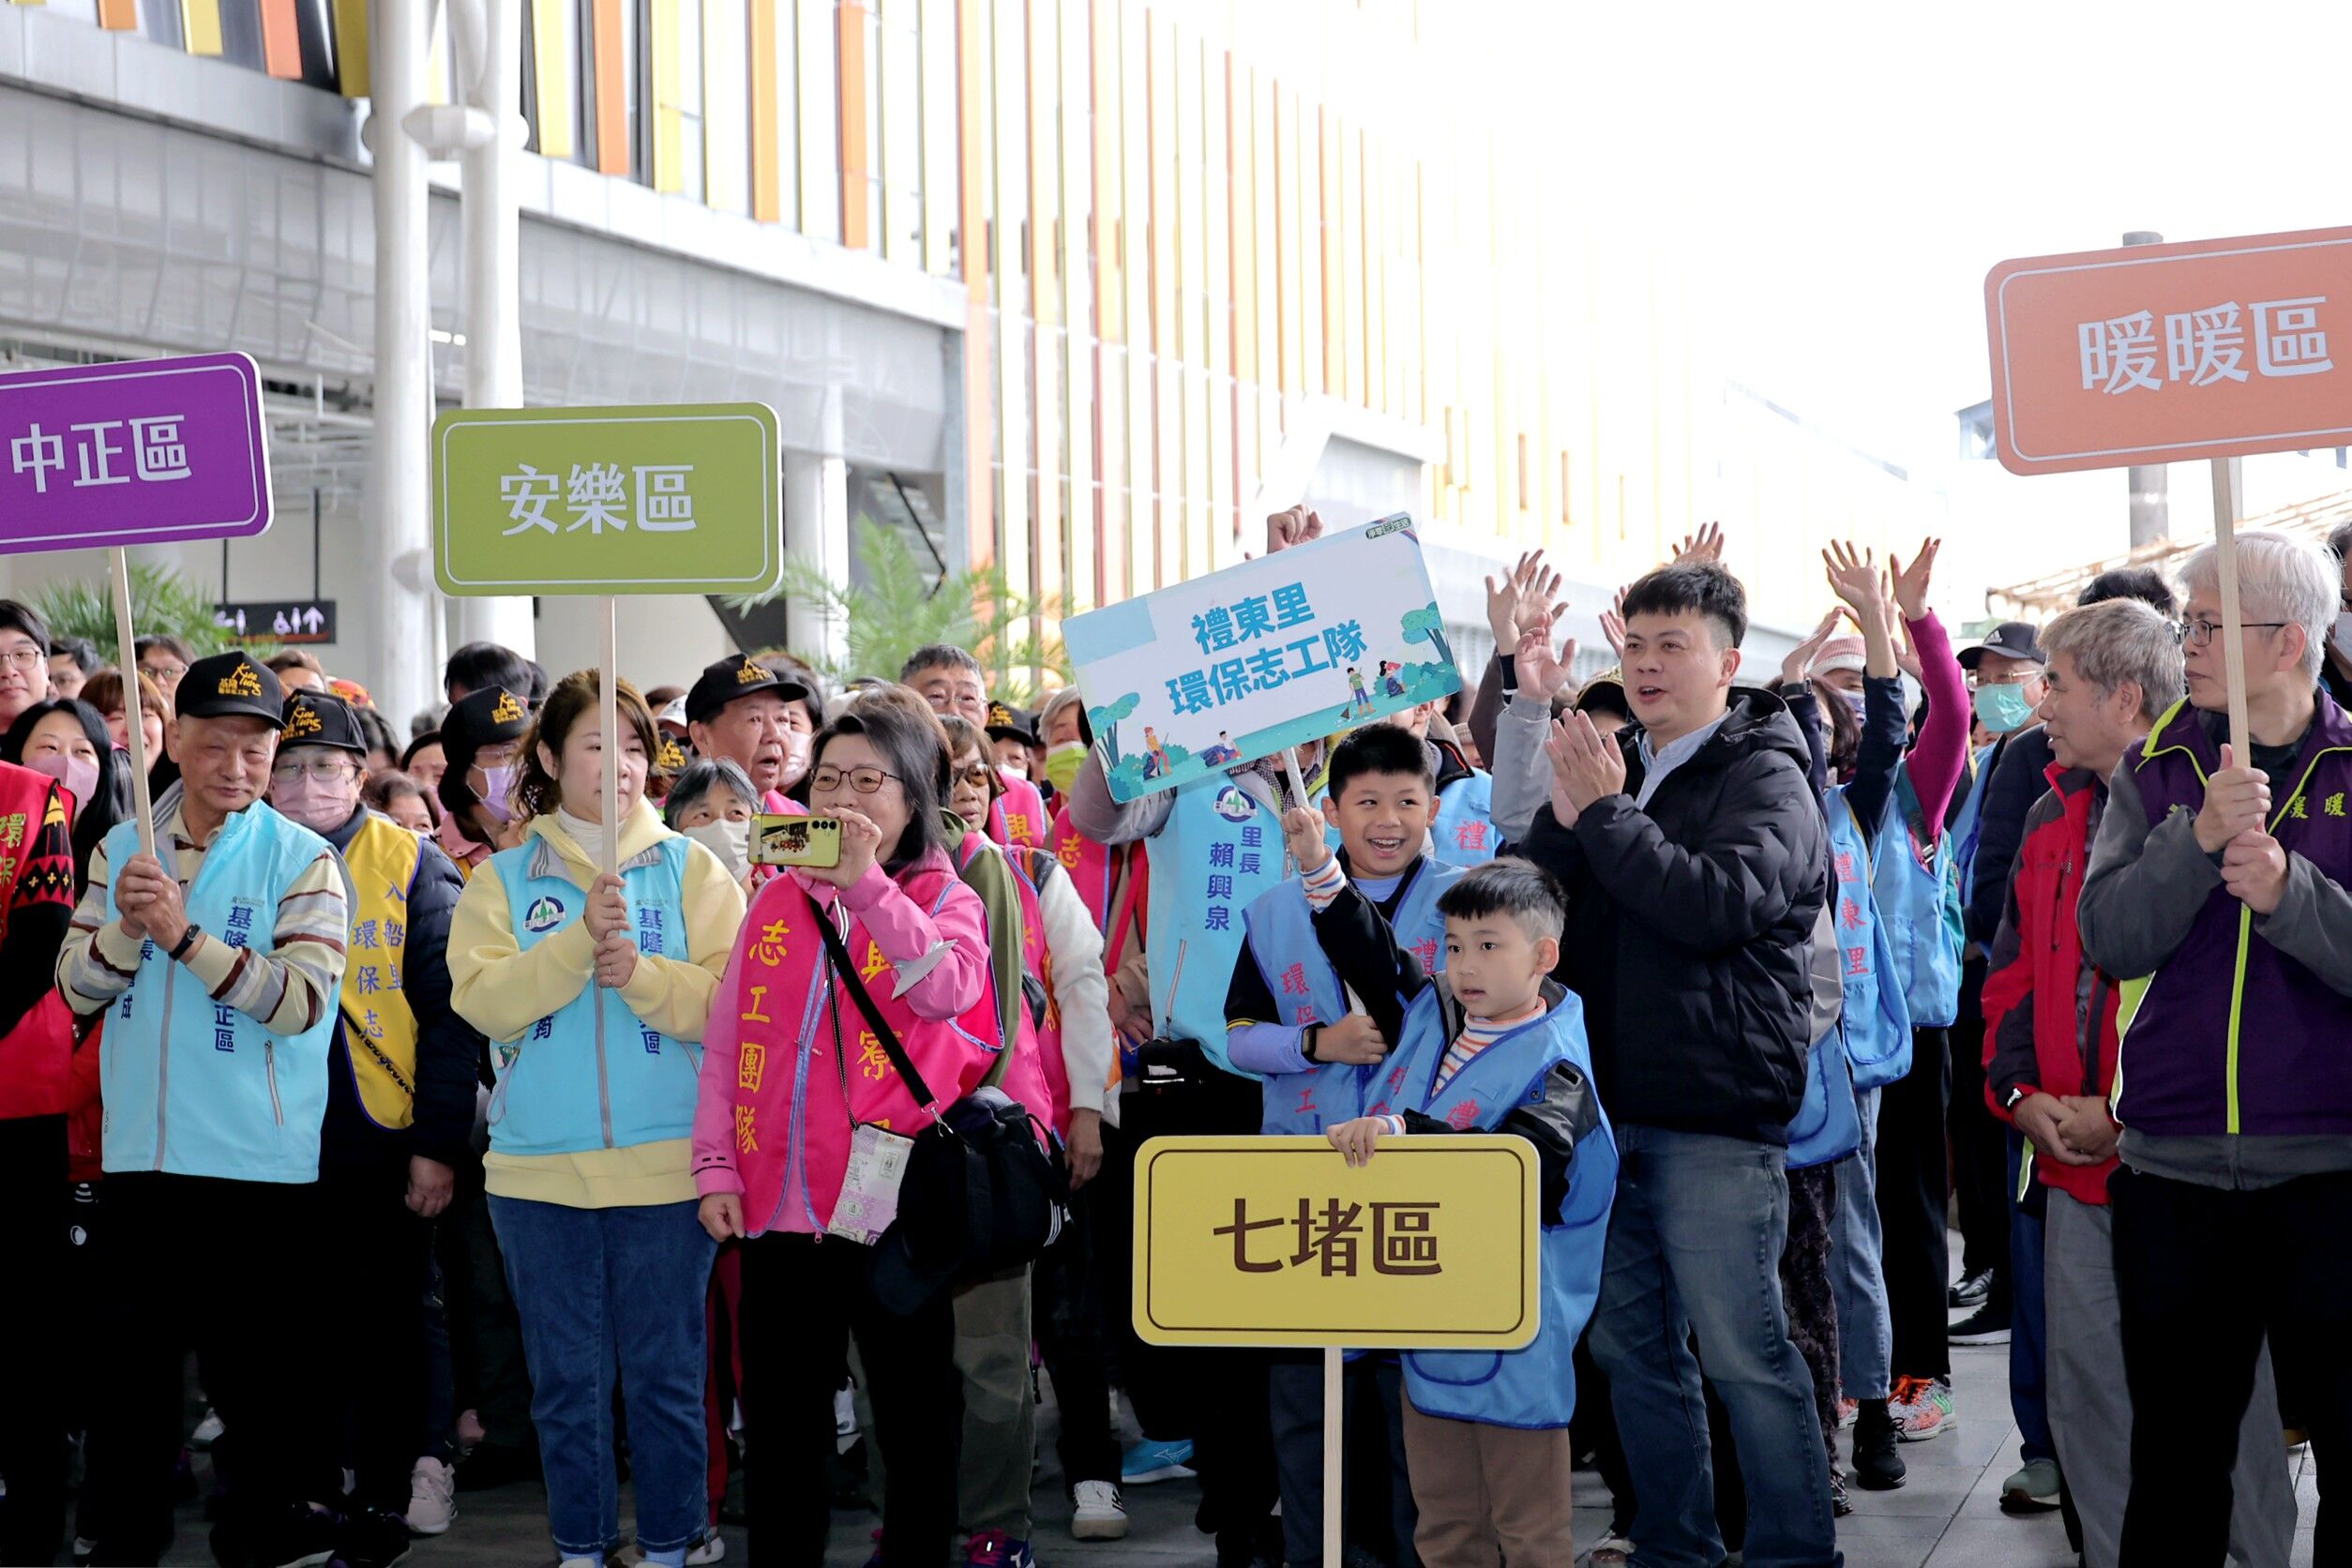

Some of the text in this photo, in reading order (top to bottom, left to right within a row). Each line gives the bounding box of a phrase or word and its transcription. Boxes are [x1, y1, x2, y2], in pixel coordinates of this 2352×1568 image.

[2077, 295, 2333, 396] 暖暖區
[10, 415, 192, 493] 中正區
[500, 462, 697, 535] 安樂區
[1191, 581, 1315, 656] 禮東里
[1165, 620, 1367, 716] 環保志工隊
[1204, 841, 1234, 931] 賴興泉
[1239, 826, 1261, 874] 里長
[353, 919, 391, 1066] 環保志
[736, 919, 791, 1154] 志工團隊
[1213, 1198, 1442, 1276] 七堵區
